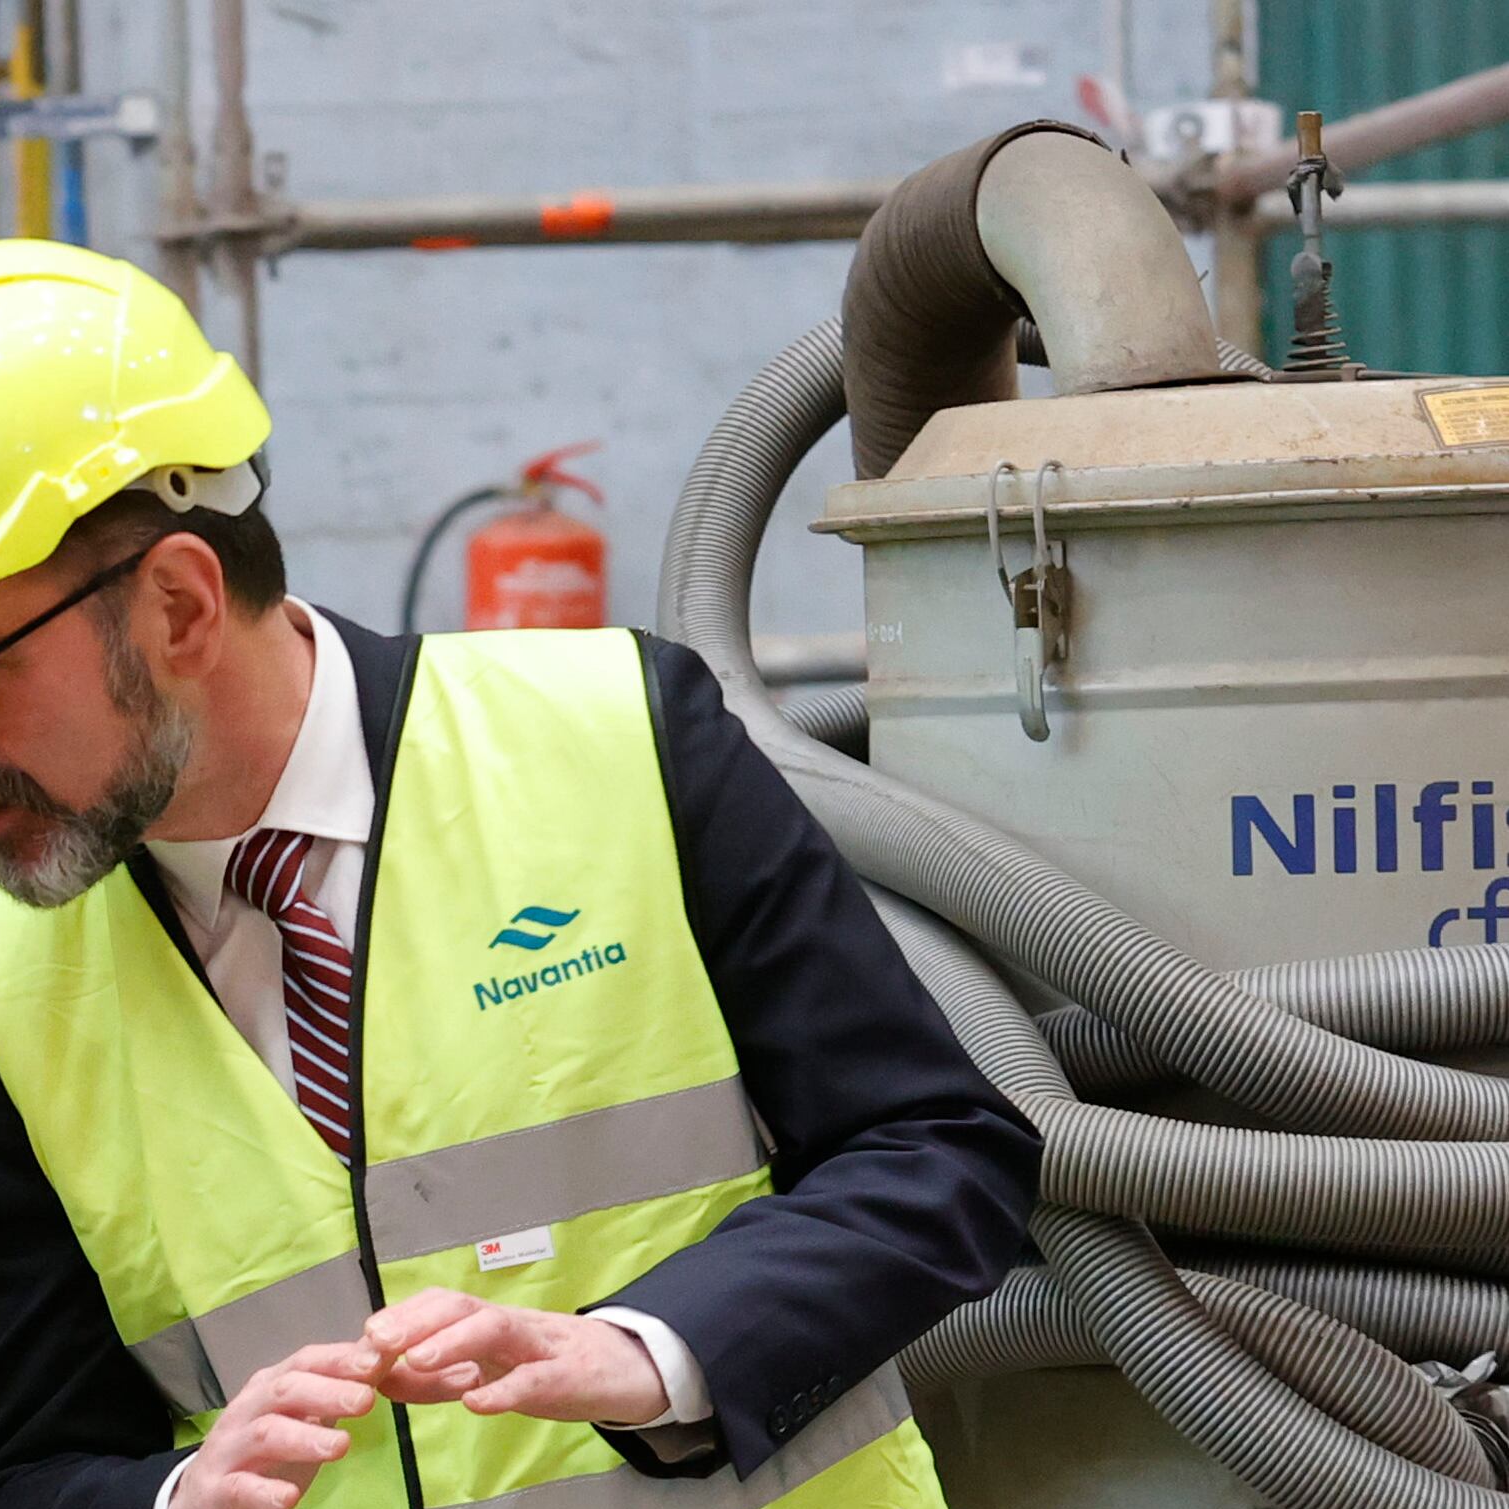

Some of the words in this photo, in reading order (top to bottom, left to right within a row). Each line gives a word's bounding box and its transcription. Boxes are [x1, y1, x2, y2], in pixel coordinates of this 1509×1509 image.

[1231, 781, 1509, 876] Nilfi
[473, 942, 626, 1011] Navantia
[480, 1242, 501, 1256] 3M
